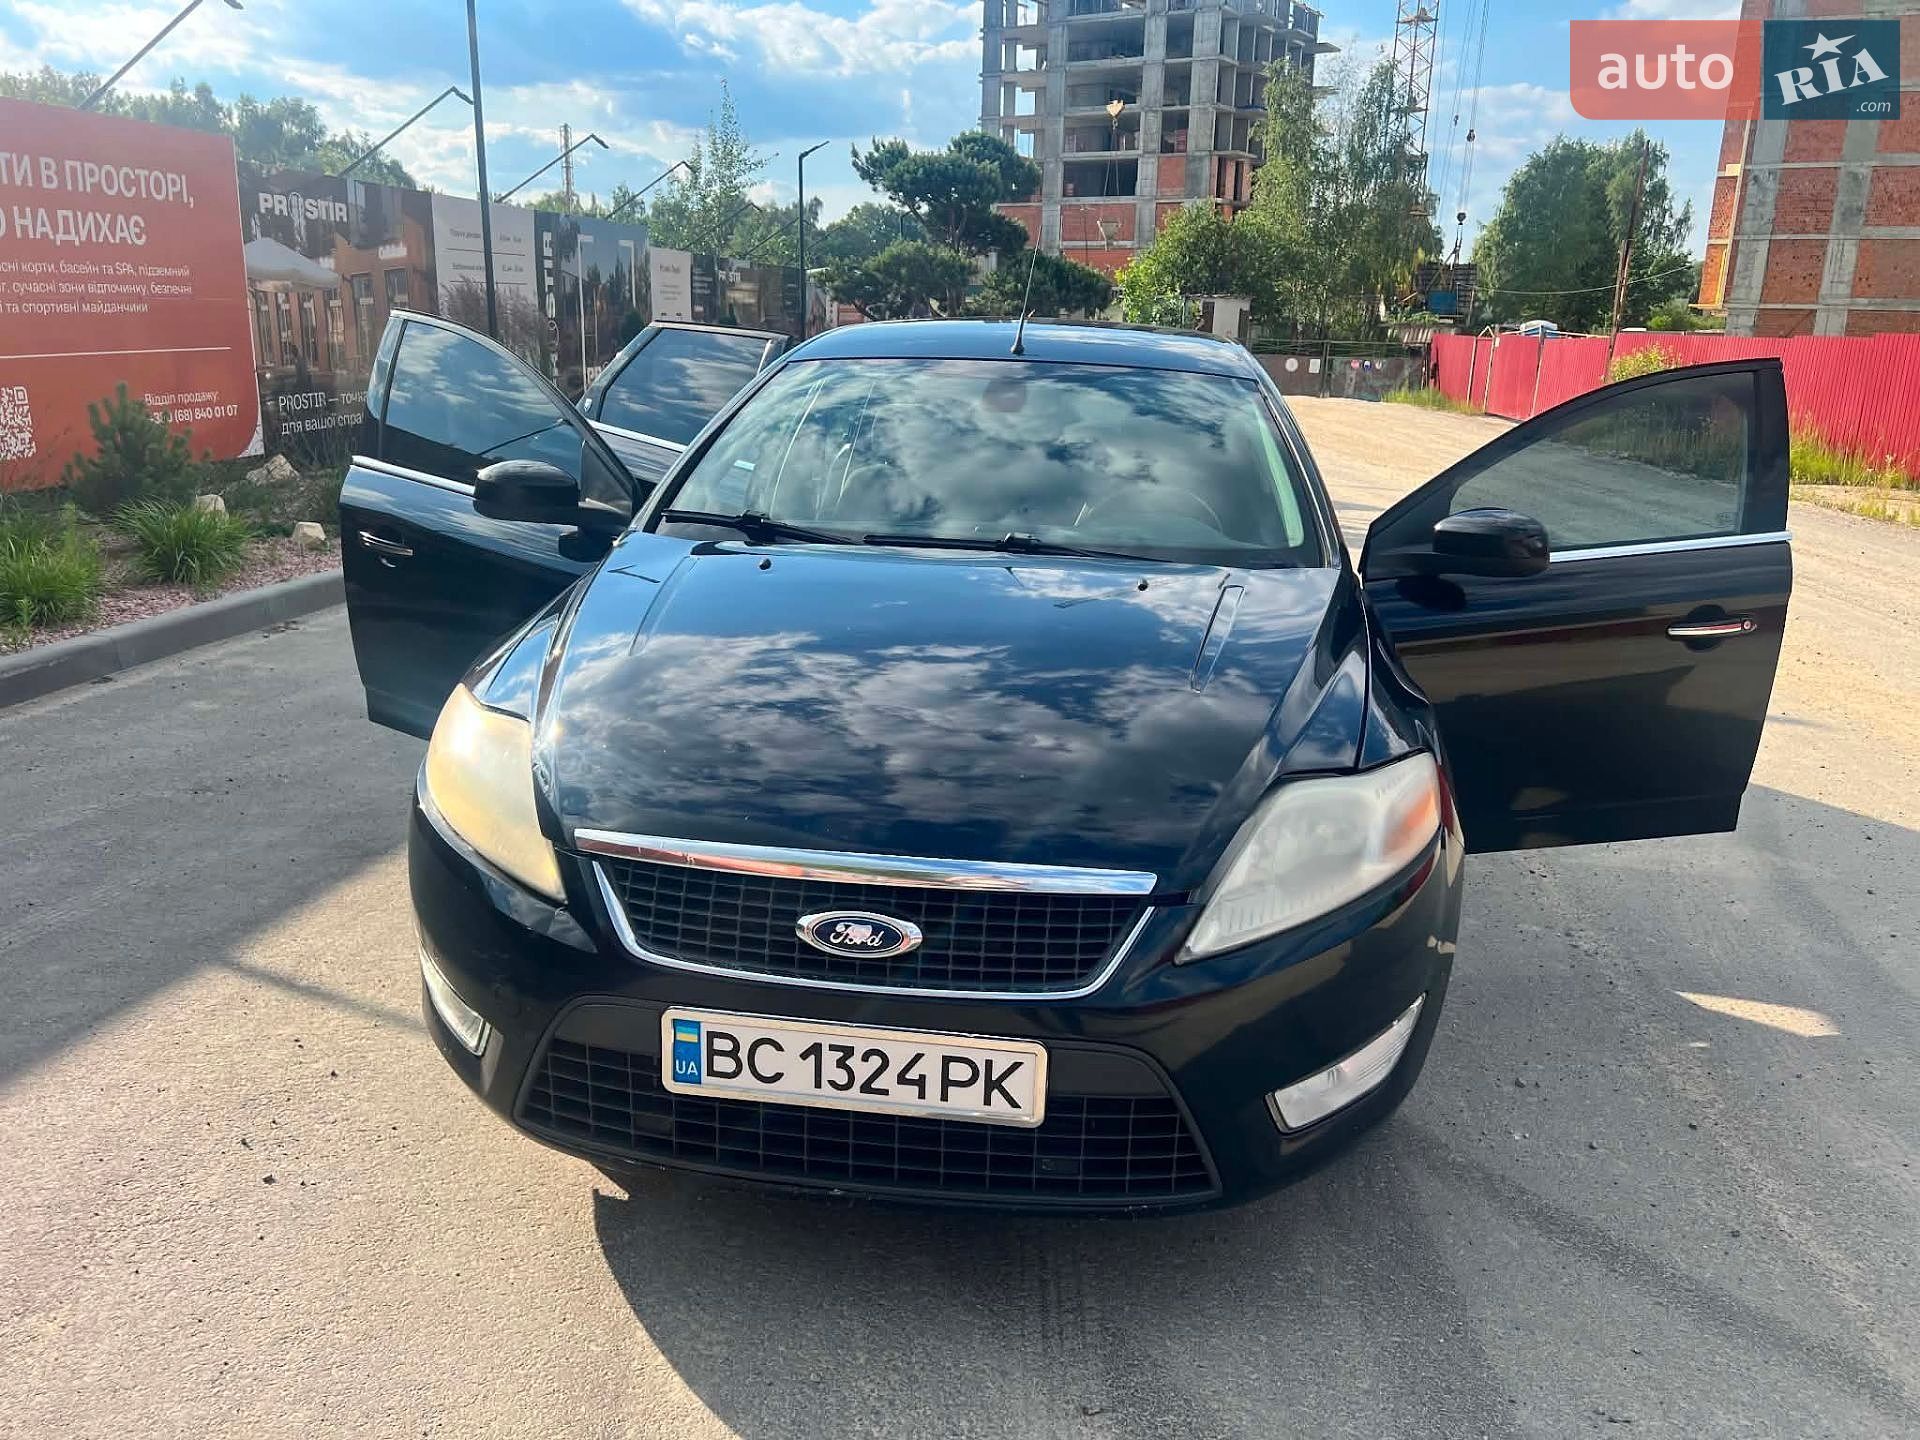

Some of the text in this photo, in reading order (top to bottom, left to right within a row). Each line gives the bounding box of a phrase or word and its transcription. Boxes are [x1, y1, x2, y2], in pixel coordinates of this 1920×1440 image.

[39, 156, 59, 190] В
[64, 160, 195, 208] ПРОСТОРІ,
[12, 205, 147, 246] НАДИХАЄ
[102, 263, 114, 275] та
[6, 303, 20, 313] та
[22, 300, 80, 316] спортивні
[194, 406, 213, 420] 840
[278, 391, 327, 413] PROSTIR
[829, 921, 884, 948] Ford
[675, 1030, 1025, 1110] UA BC 1324 PK
